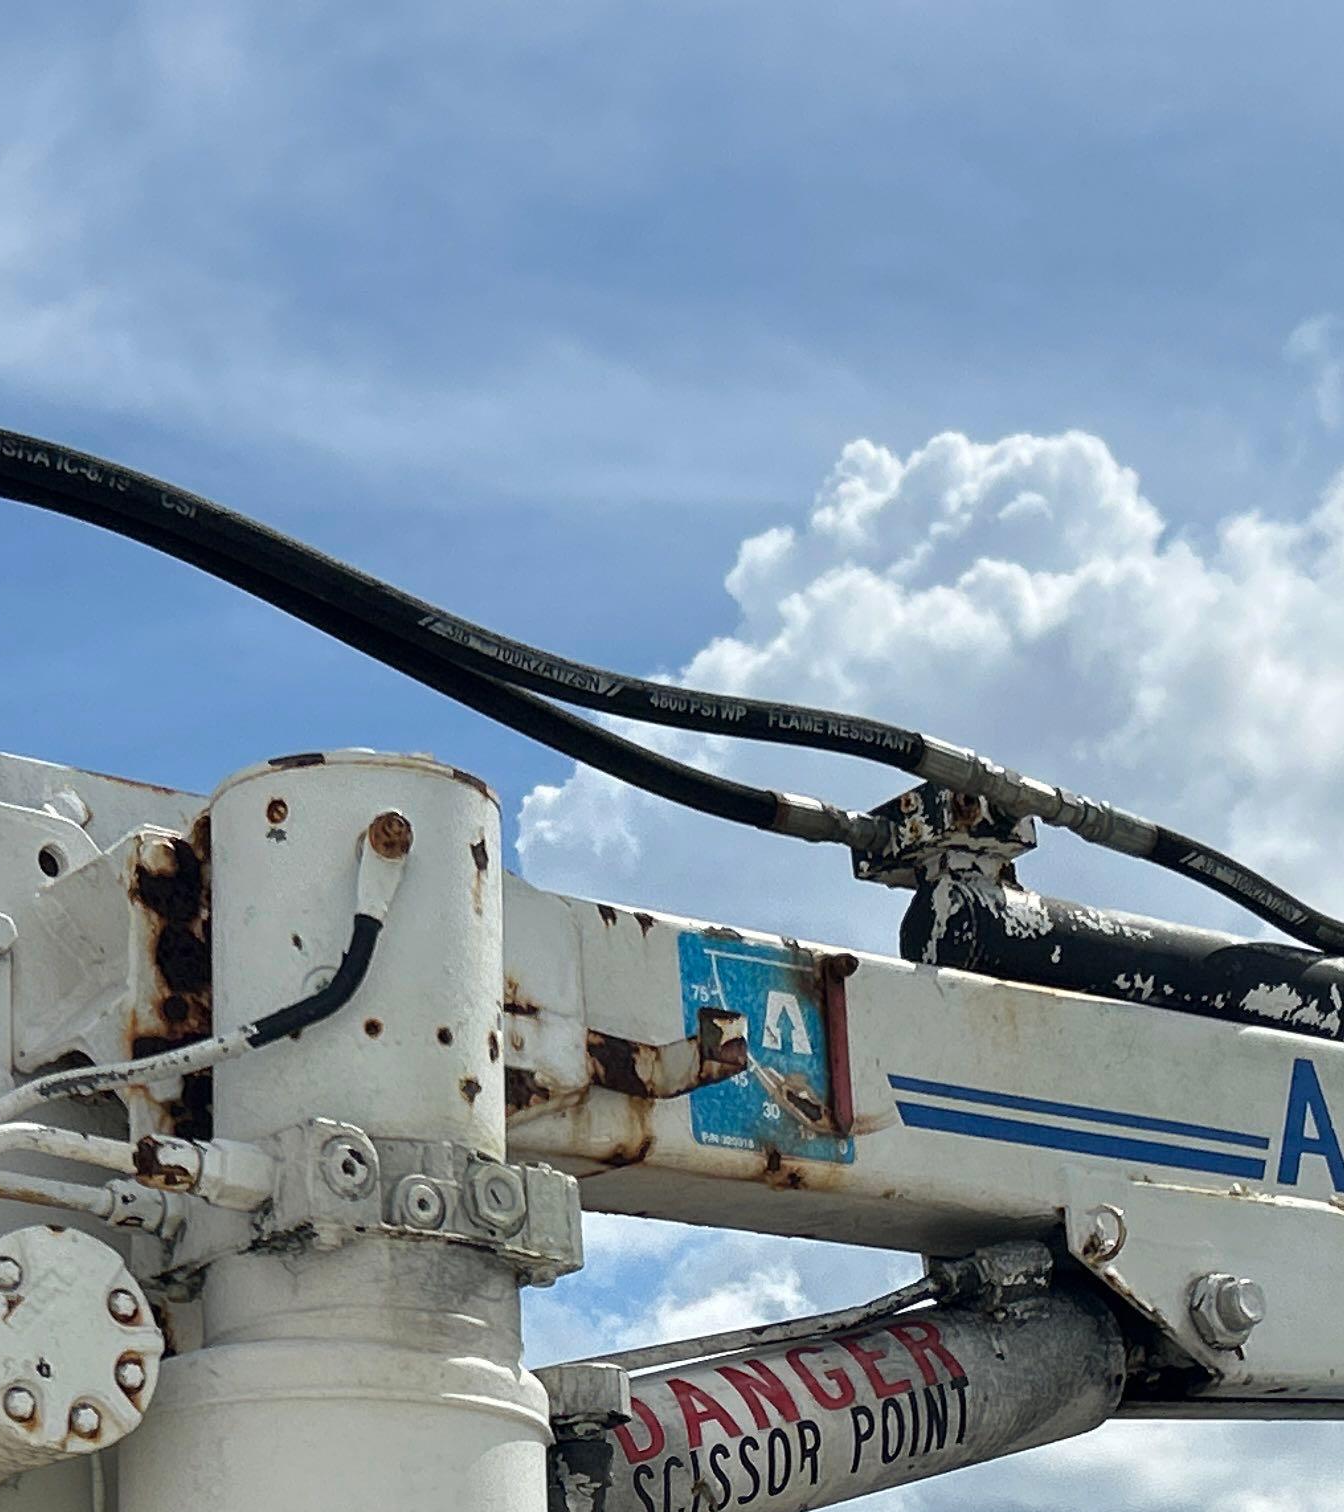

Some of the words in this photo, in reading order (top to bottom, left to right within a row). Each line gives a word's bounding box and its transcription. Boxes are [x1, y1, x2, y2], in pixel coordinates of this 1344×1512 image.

[690, 698, 717, 718] PSI
[721, 703, 748, 723] WP
[768, 710, 824, 734] FLAME
[827, 716, 915, 754] RESISTANT
[690, 984, 710, 1003] 75
[762, 1100, 781, 1119] 30
[611, 1319, 966, 1465] DANGER
[850, 1375, 971, 1475] POINT
